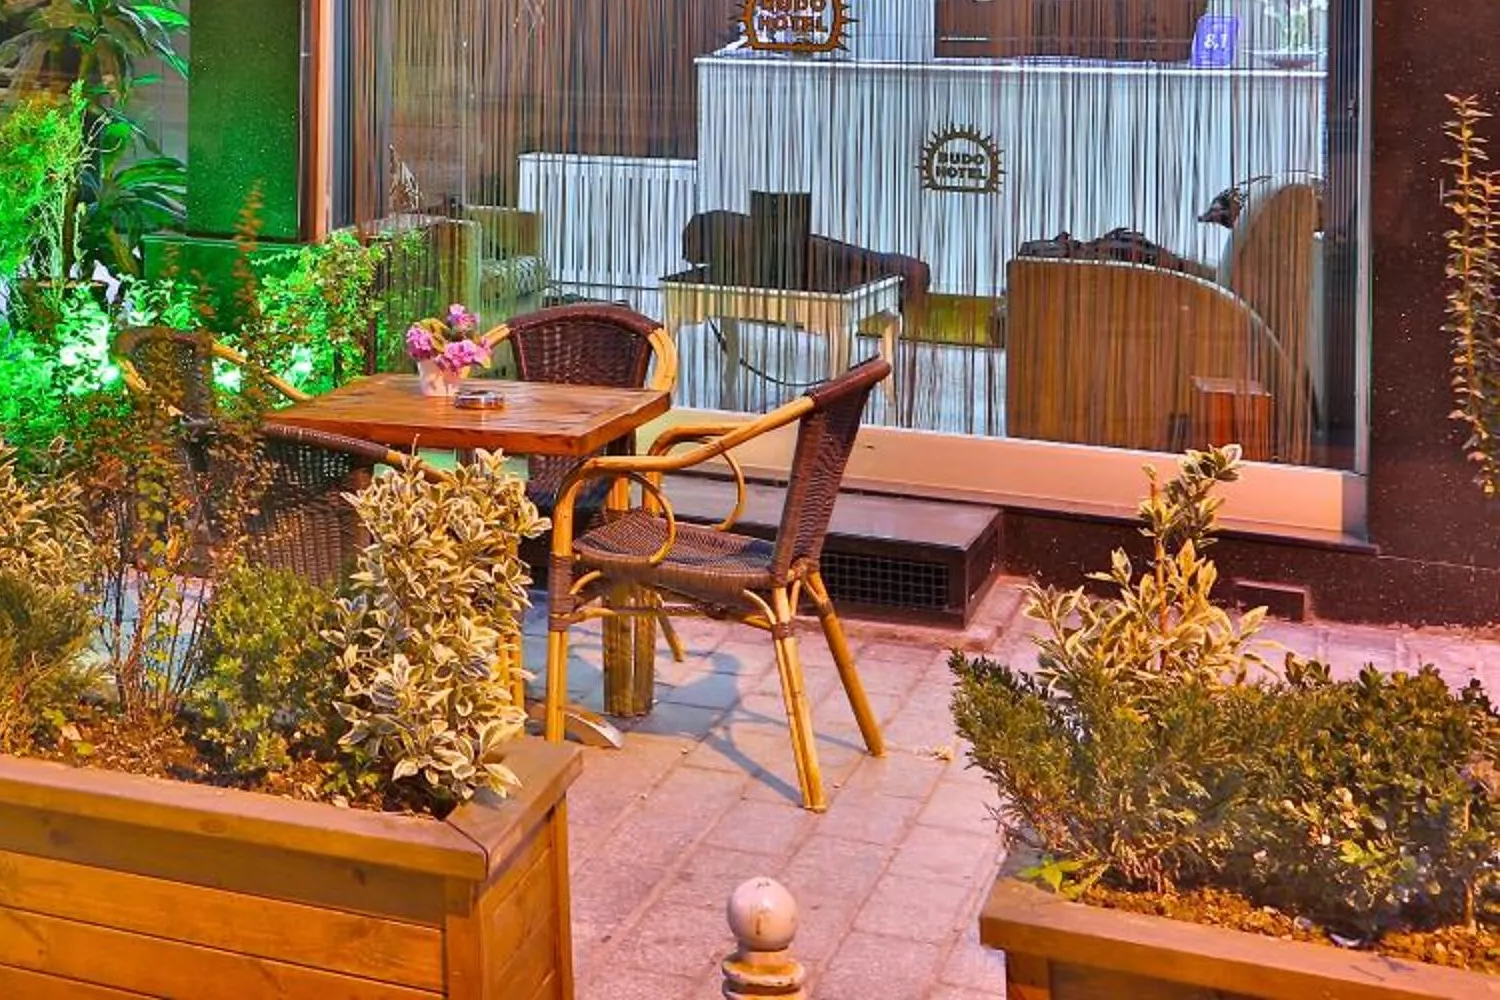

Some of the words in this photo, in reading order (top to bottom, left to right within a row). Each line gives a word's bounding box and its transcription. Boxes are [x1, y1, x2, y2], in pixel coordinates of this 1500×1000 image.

[757, 15, 829, 33] HOTEL
[937, 151, 985, 165] BUDO
[935, 165, 988, 179] HOTEL
